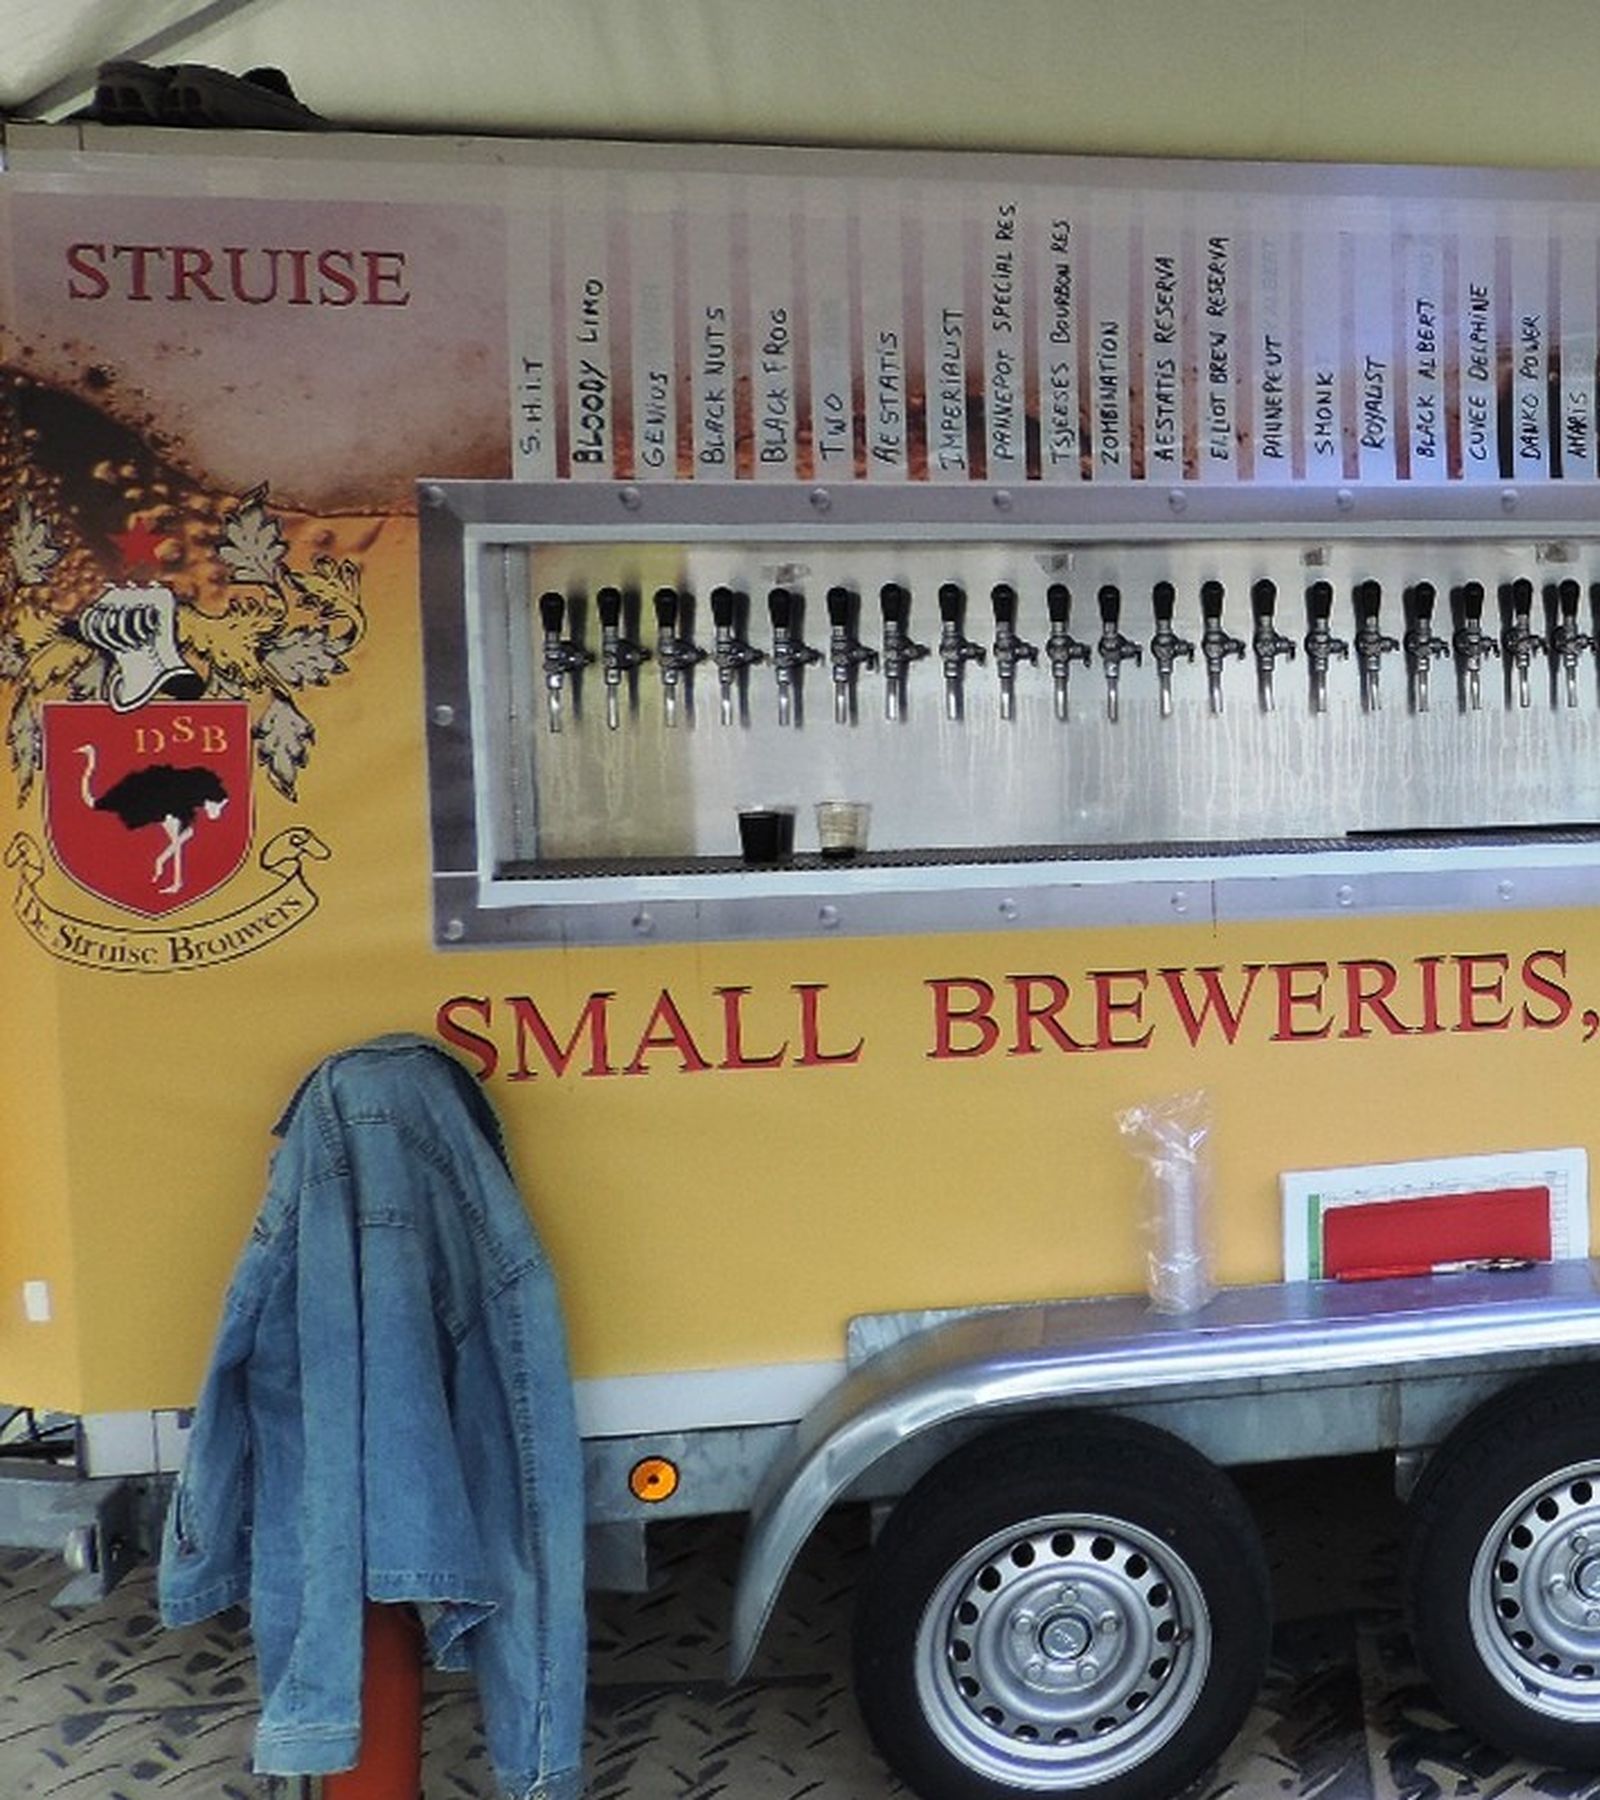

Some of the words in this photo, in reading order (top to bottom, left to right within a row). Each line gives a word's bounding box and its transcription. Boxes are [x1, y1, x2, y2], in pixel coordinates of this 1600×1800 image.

[66, 242, 412, 307] STRUISE
[1050, 261, 1073, 344] BOURBON
[1153, 255, 1176, 345] RESERVA
[1207, 235, 1230, 320] RESERVA
[581, 277, 605, 344] LIMO
[702, 306, 727, 378] NUTS
[764, 307, 789, 377] FROG
[1415, 297, 1437, 382] ALBERT
[1211, 330, 1229, 385] BREW
[1520, 314, 1542, 382] POWER
[573, 359, 610, 465] BLOODY
[699, 388, 727, 466] BLACK
[761, 386, 789, 465] BLACK
[820, 392, 846, 459] TWO
[1313, 369, 1335, 457] SMONK
[1415, 392, 1435, 459] BLACK
[1468, 395, 1488, 462] CUVEE
[1518, 392, 1542, 462] DANKO
[57, 924, 160, 966] Struise
[168, 895, 304, 966] Brouwers
[433, 983, 865, 1084] SMALL
